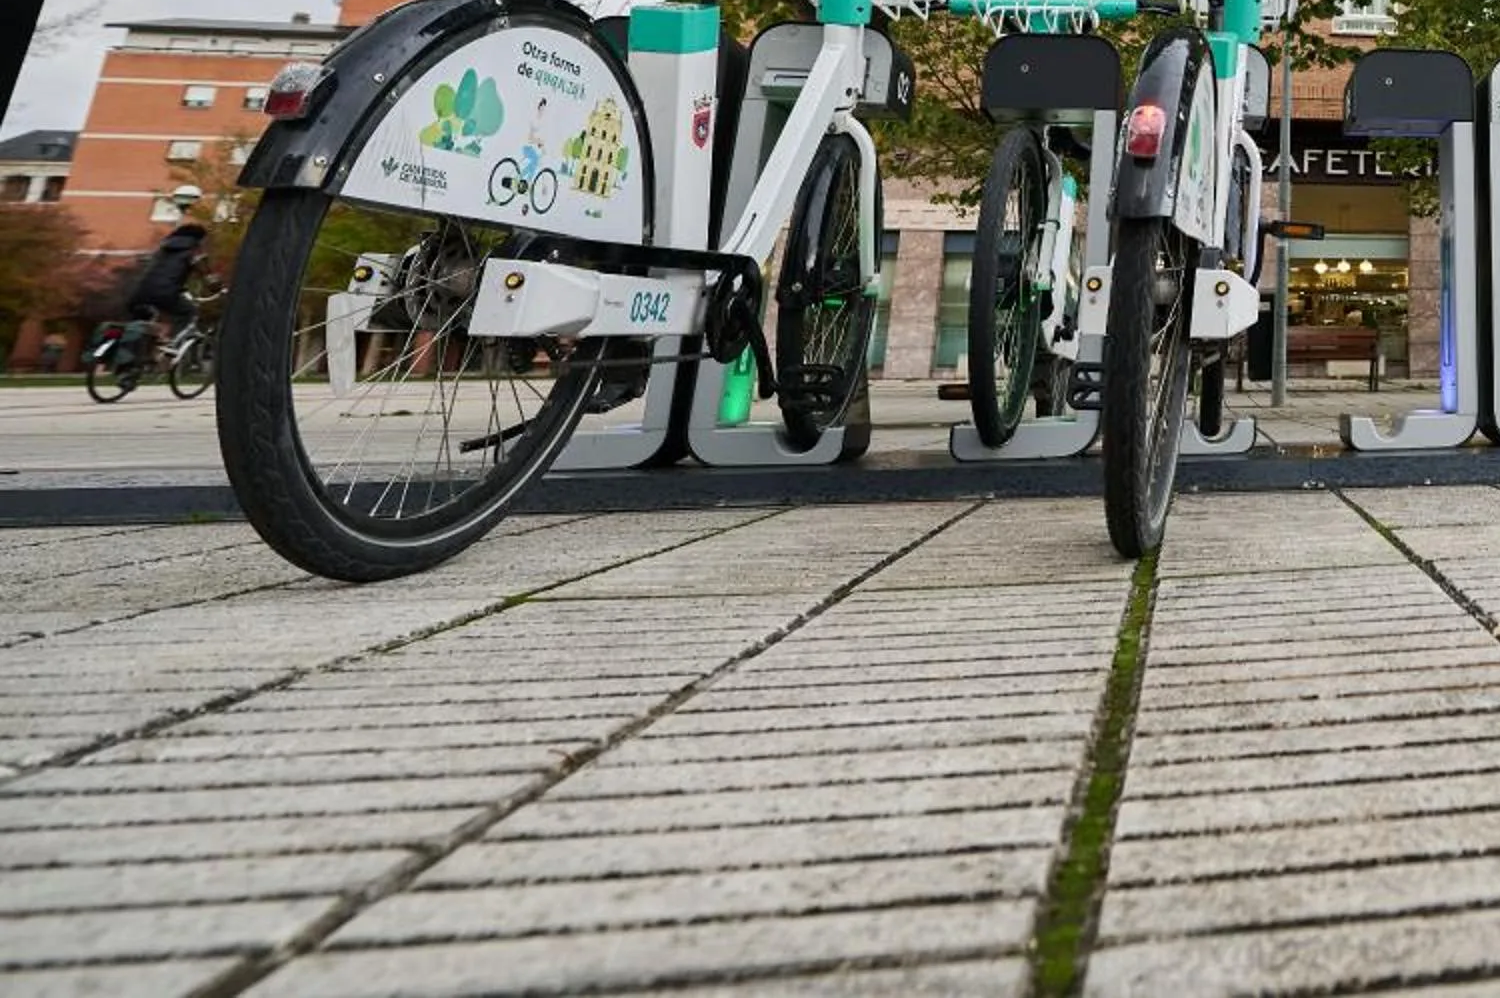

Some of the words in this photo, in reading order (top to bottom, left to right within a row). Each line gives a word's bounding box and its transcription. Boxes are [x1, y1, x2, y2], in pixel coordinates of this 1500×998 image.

[517, 62, 533, 79] de
[522, 41, 548, 63] Otra
[549, 51, 581, 76] forma
[896, 71, 911, 105] 02
[1244, 147, 1440, 177] AFETEI
[630, 291, 671, 323] 0342
